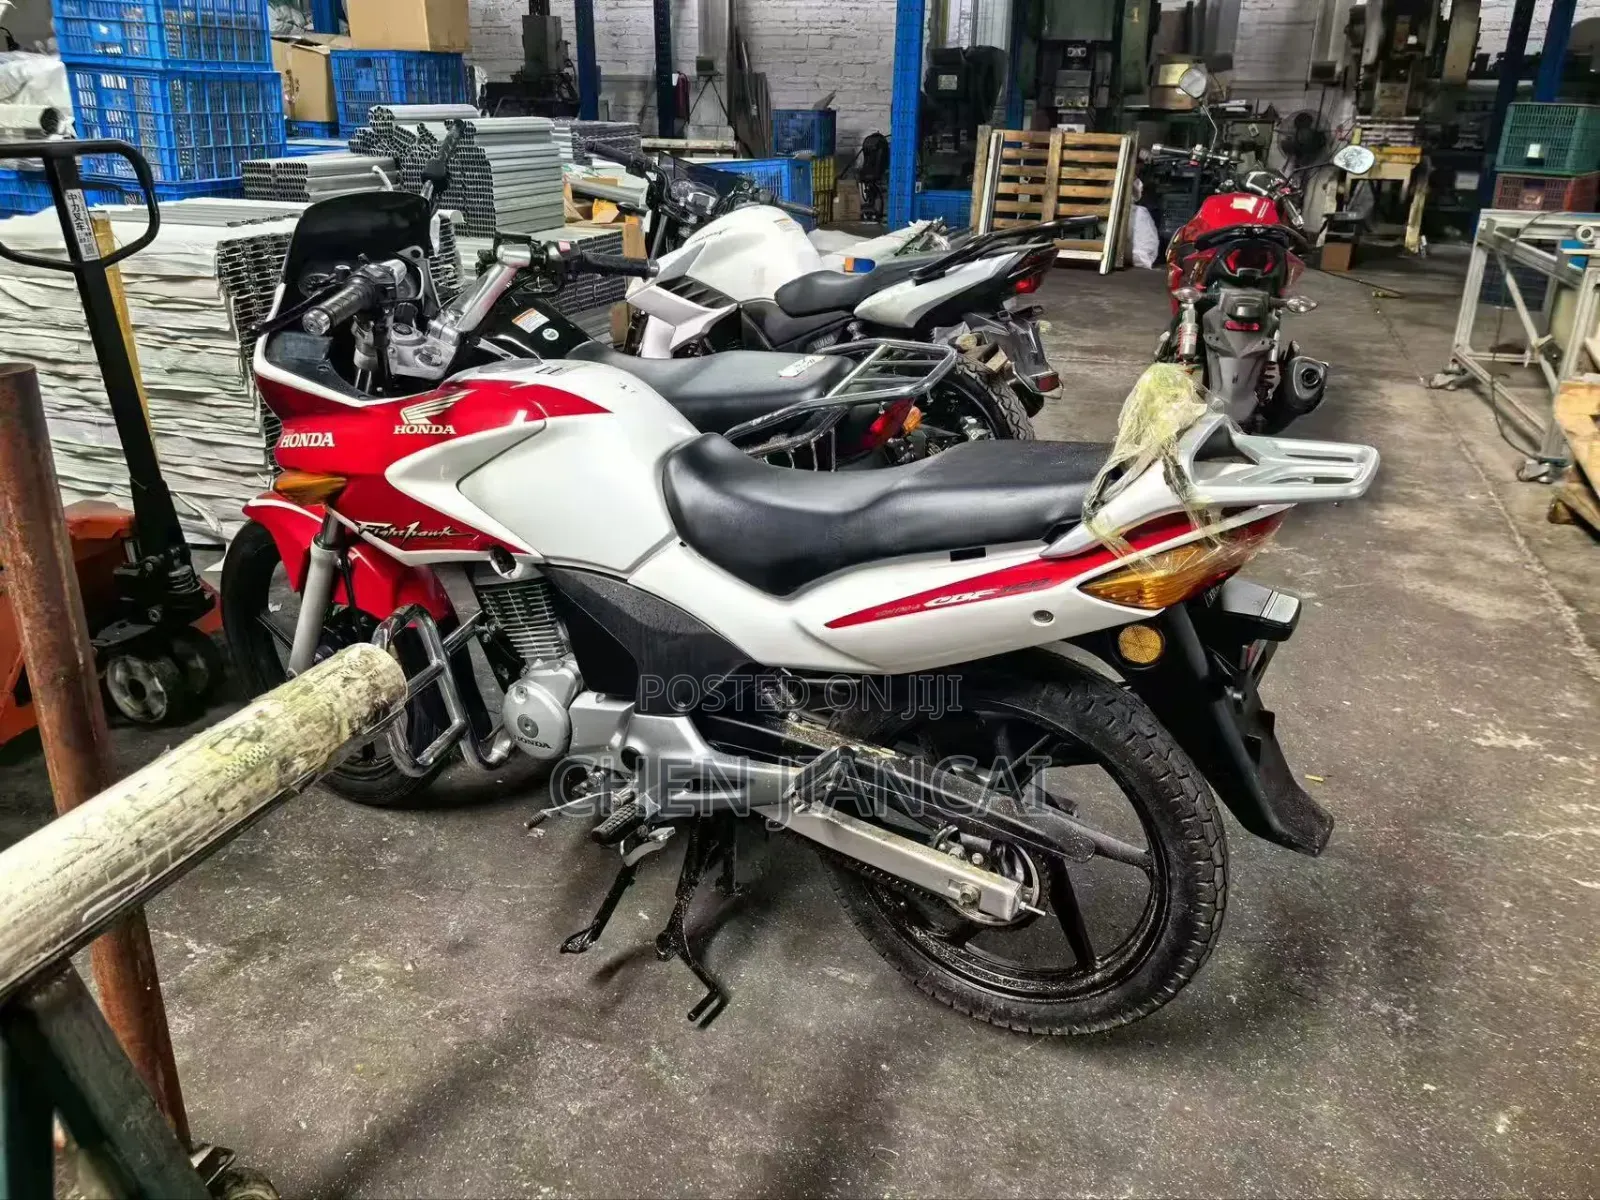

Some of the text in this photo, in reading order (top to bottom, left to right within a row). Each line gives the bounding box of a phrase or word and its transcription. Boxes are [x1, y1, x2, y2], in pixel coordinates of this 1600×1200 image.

[393, 425, 457, 435] HONDA
[279, 432, 335, 448] HONDA
[513, 735, 552, 749] HONDA
